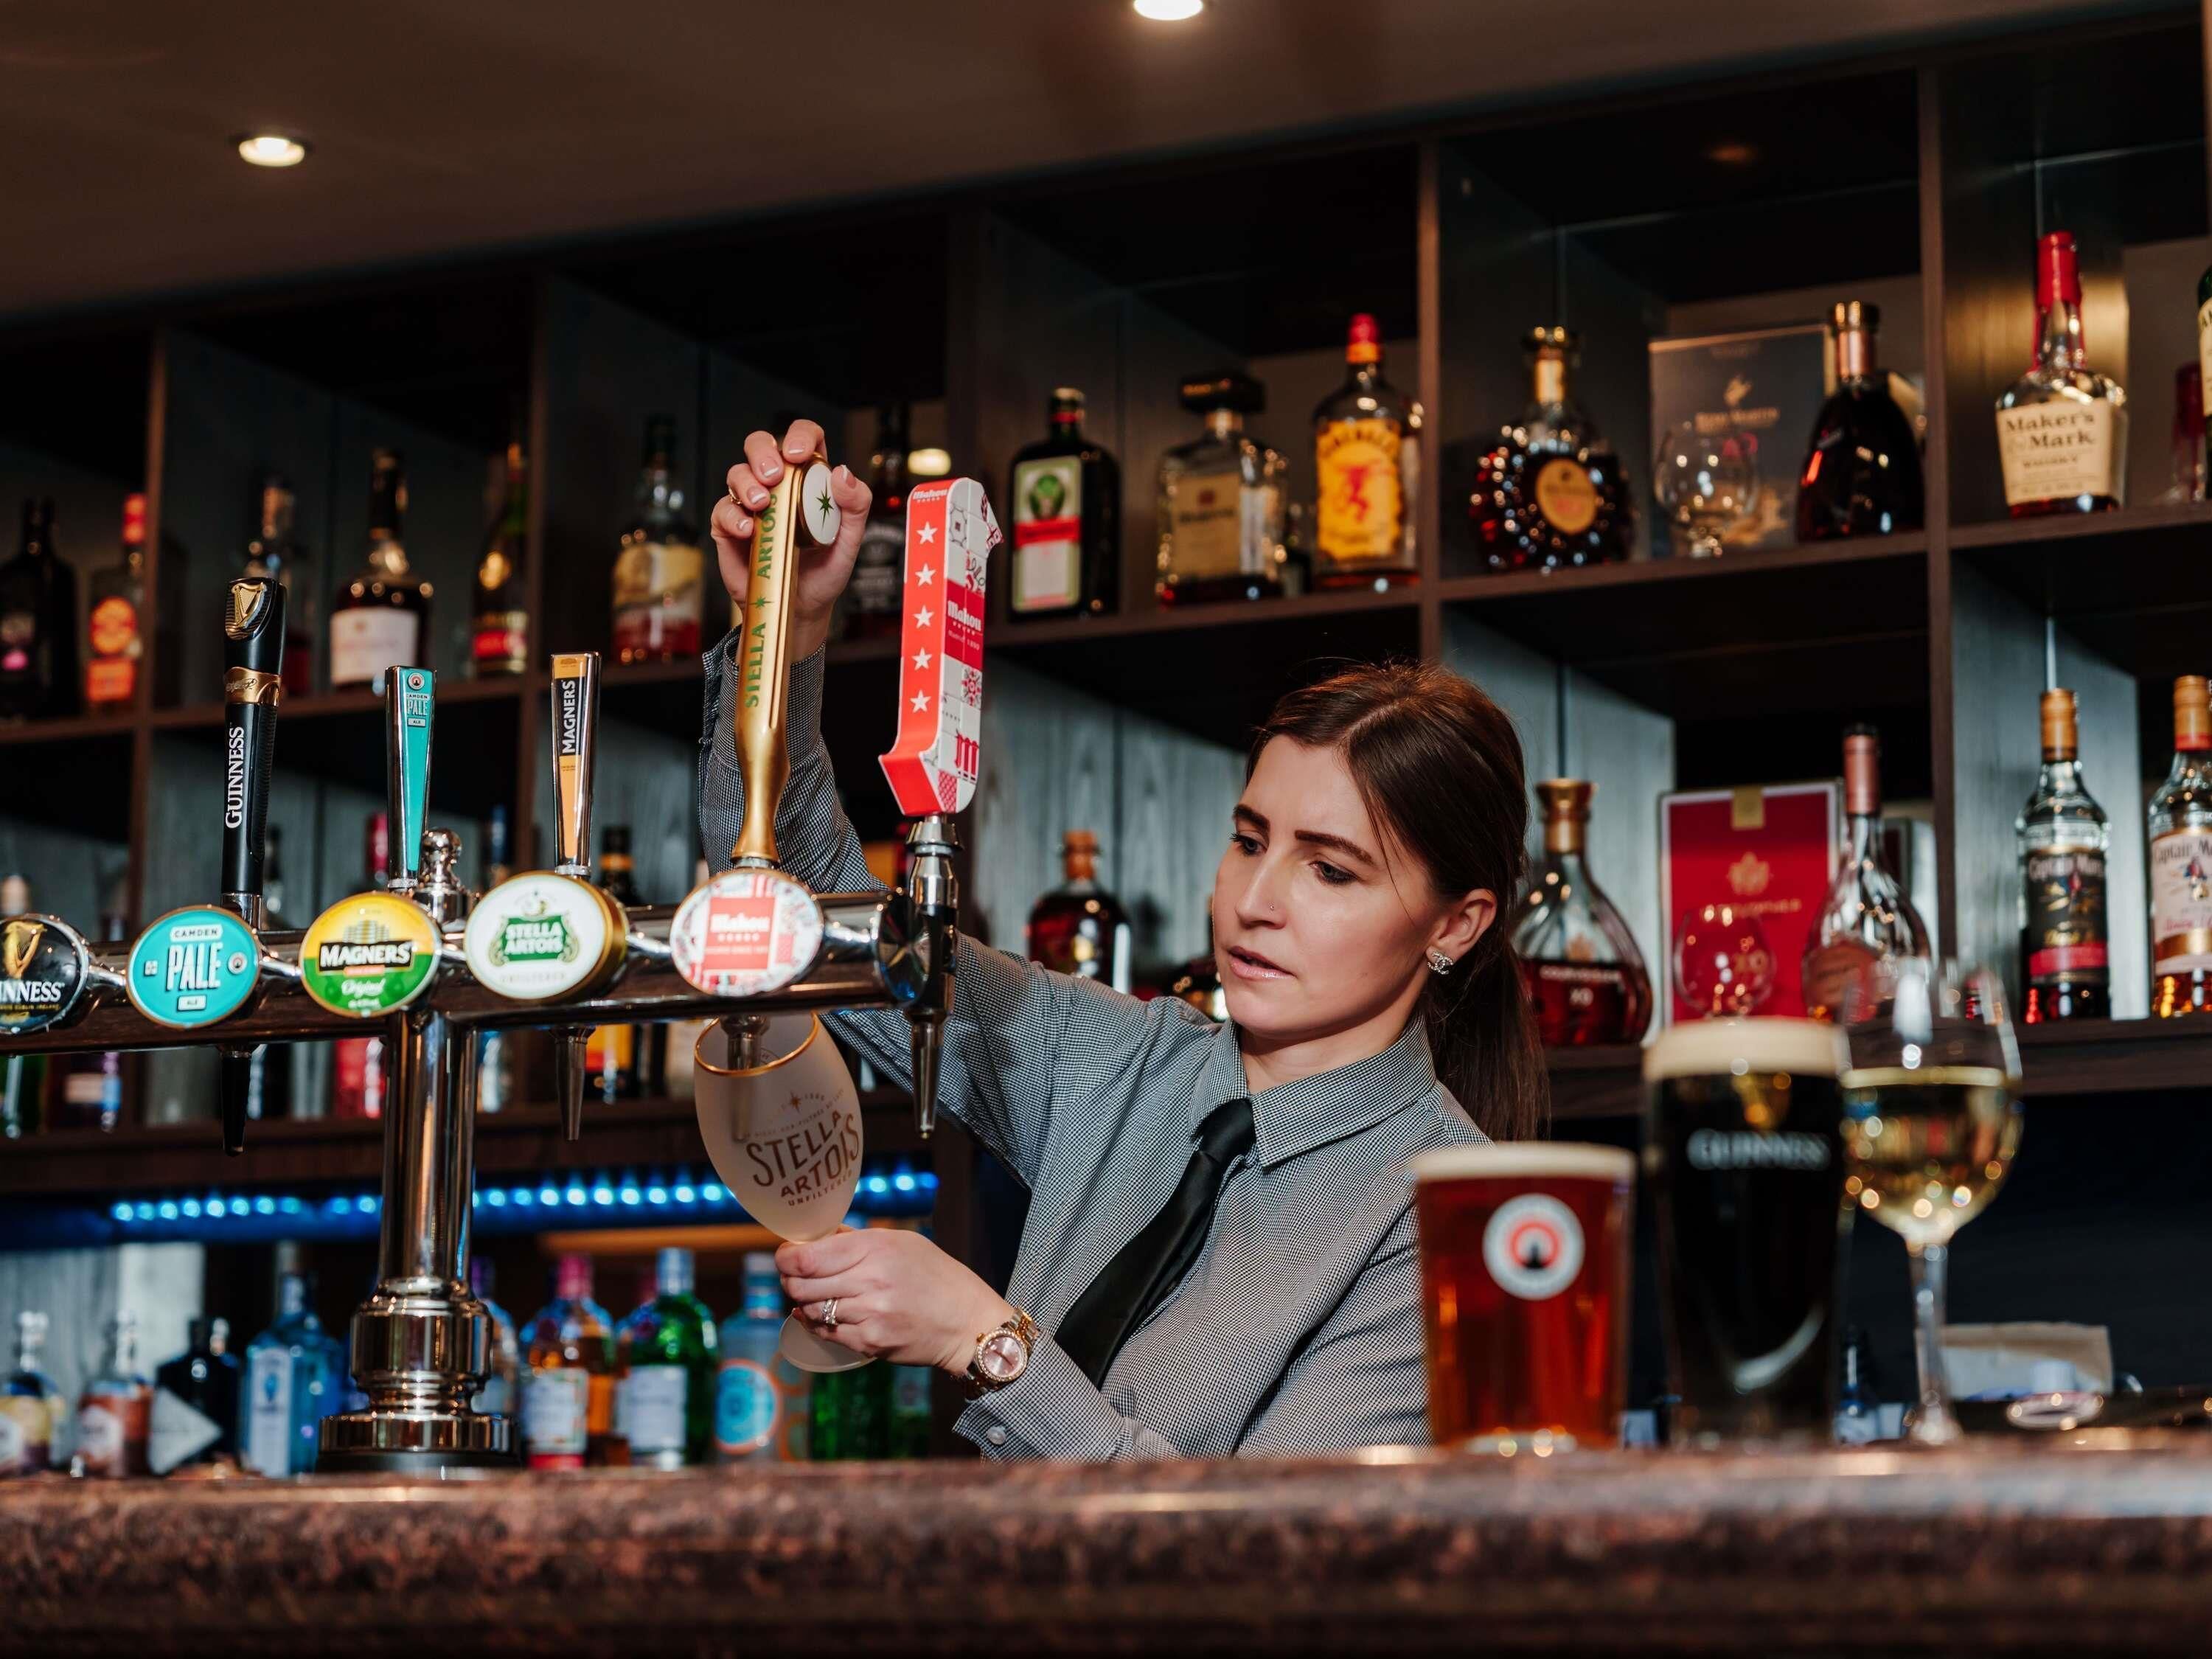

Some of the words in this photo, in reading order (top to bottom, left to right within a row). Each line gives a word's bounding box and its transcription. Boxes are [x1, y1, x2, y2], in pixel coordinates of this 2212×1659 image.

[2005, 411, 2095, 432] Maker's
[2031, 429, 2095, 448] Mark
[913, 488, 948, 501] Mahou
[947, 599, 981, 632] Mahou
[407, 699, 429, 716] PALE
[562, 680, 576, 754] MAGNERS
[225, 726, 245, 829] GUINNESS
[174, 928, 218, 938] CAMDEN
[506, 922, 563, 941] STELLA
[319, 941, 414, 968] MAGNERS
[504, 936, 564, 955] ARTOIS
[165, 942, 223, 992] PALE
[746, 1110, 842, 1187] STELLA
[781, 1113, 860, 1198] ARTOIS
